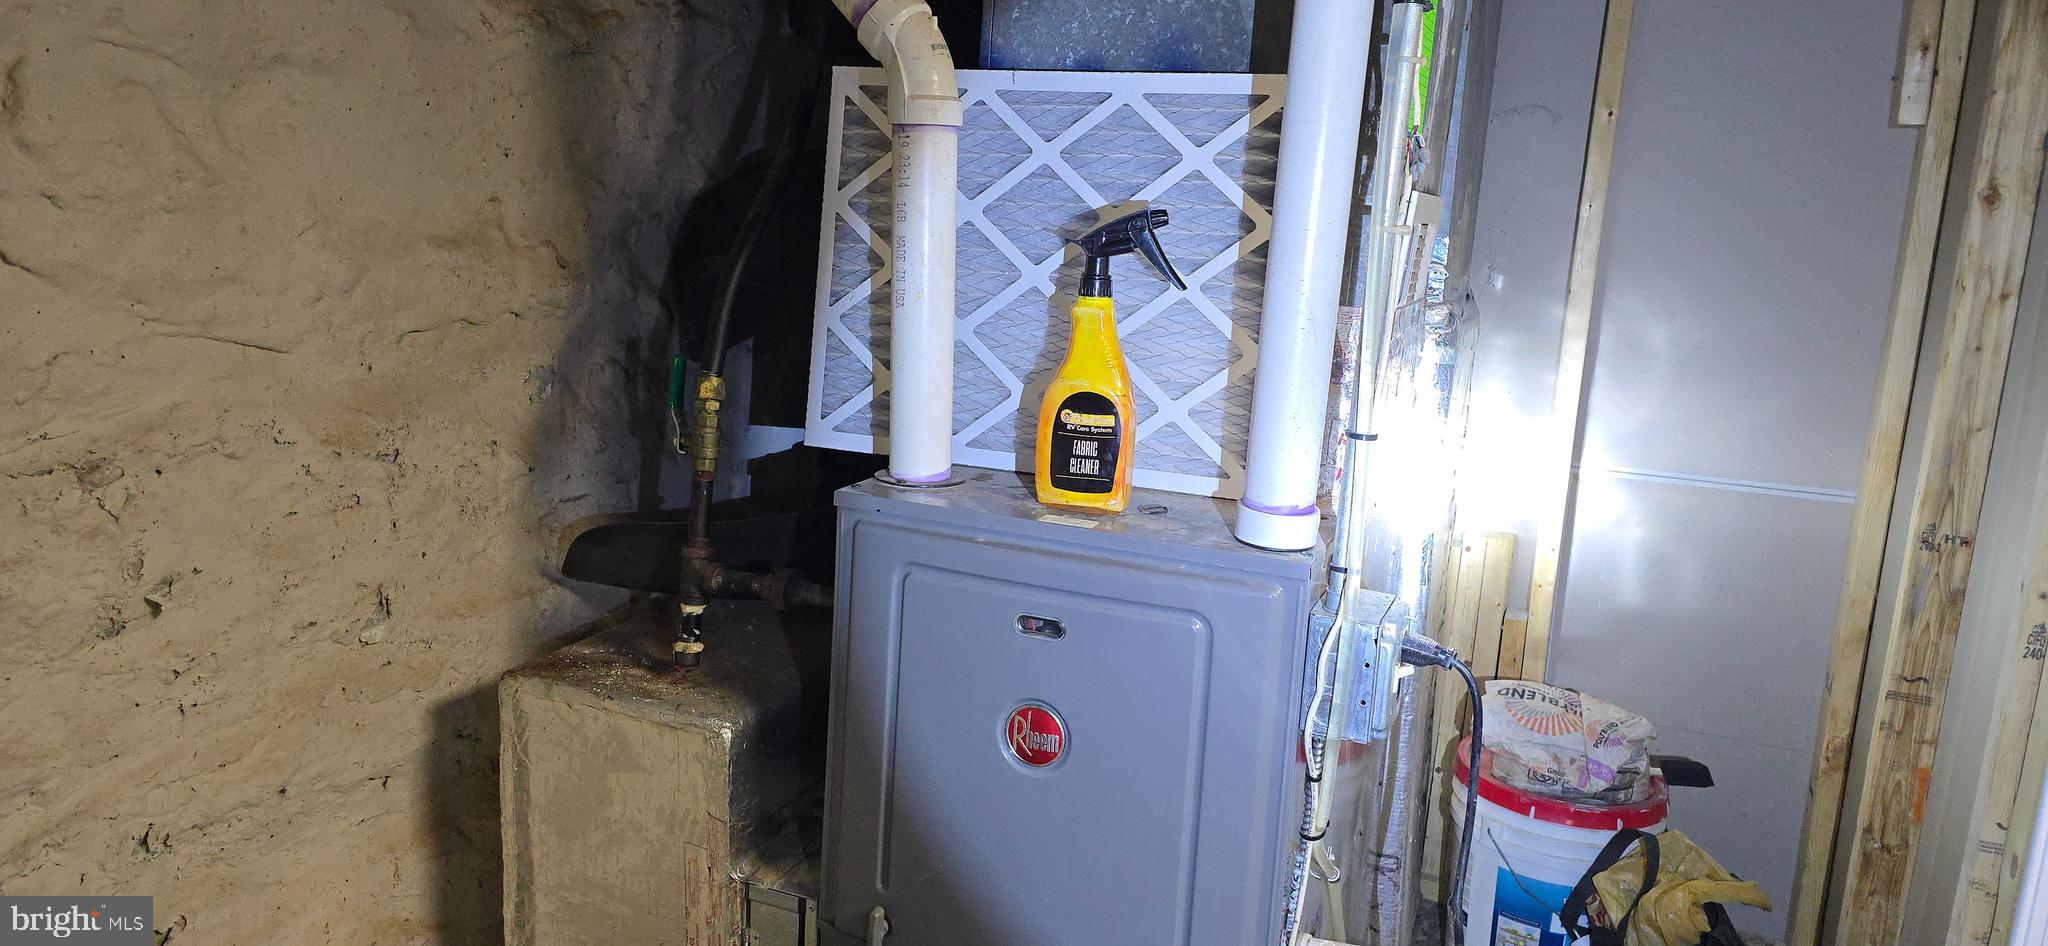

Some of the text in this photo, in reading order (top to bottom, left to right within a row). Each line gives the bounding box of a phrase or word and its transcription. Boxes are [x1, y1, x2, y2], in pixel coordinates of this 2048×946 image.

[898, 155, 911, 188] 23:14
[895, 235, 907, 263] MADE
[896, 269, 906, 282] IN
[895, 288, 905, 309] USA
[1090, 426, 1113, 434] System
[1072, 440, 1098, 457] FABRIC
[1069, 458, 1100, 475] CLEANER
[1012, 710, 1060, 757] Rheem
